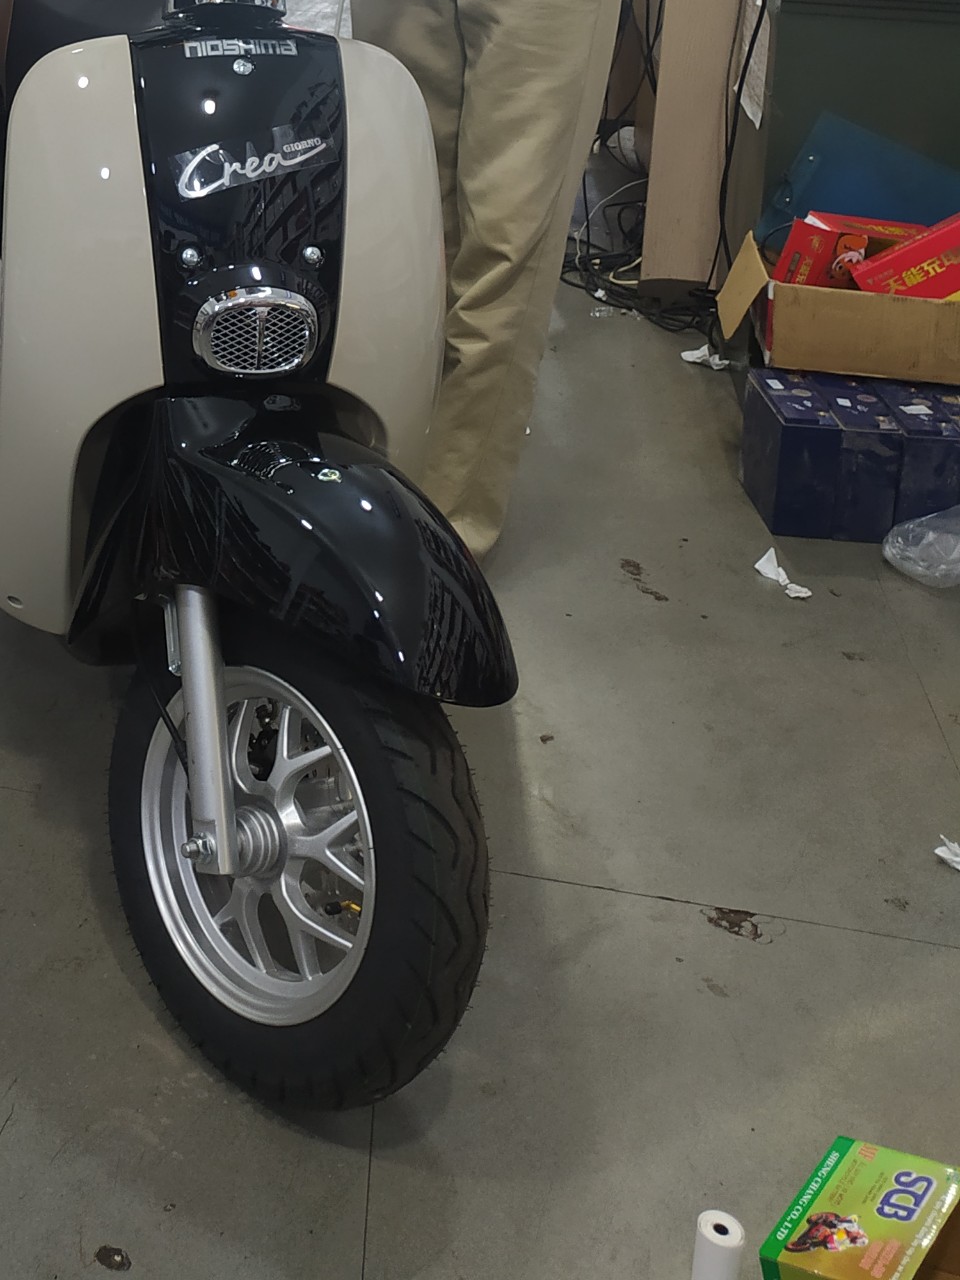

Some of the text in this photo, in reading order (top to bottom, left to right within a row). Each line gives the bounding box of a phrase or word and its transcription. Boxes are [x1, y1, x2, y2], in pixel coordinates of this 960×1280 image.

[283, 137, 321, 154] GIORNO
[177, 142, 326, 199] Crea
[819, 1150, 840, 1180] SHENG
[798, 1175, 821, 1207] CHANG
[776, 1219, 792, 1240] LTD
